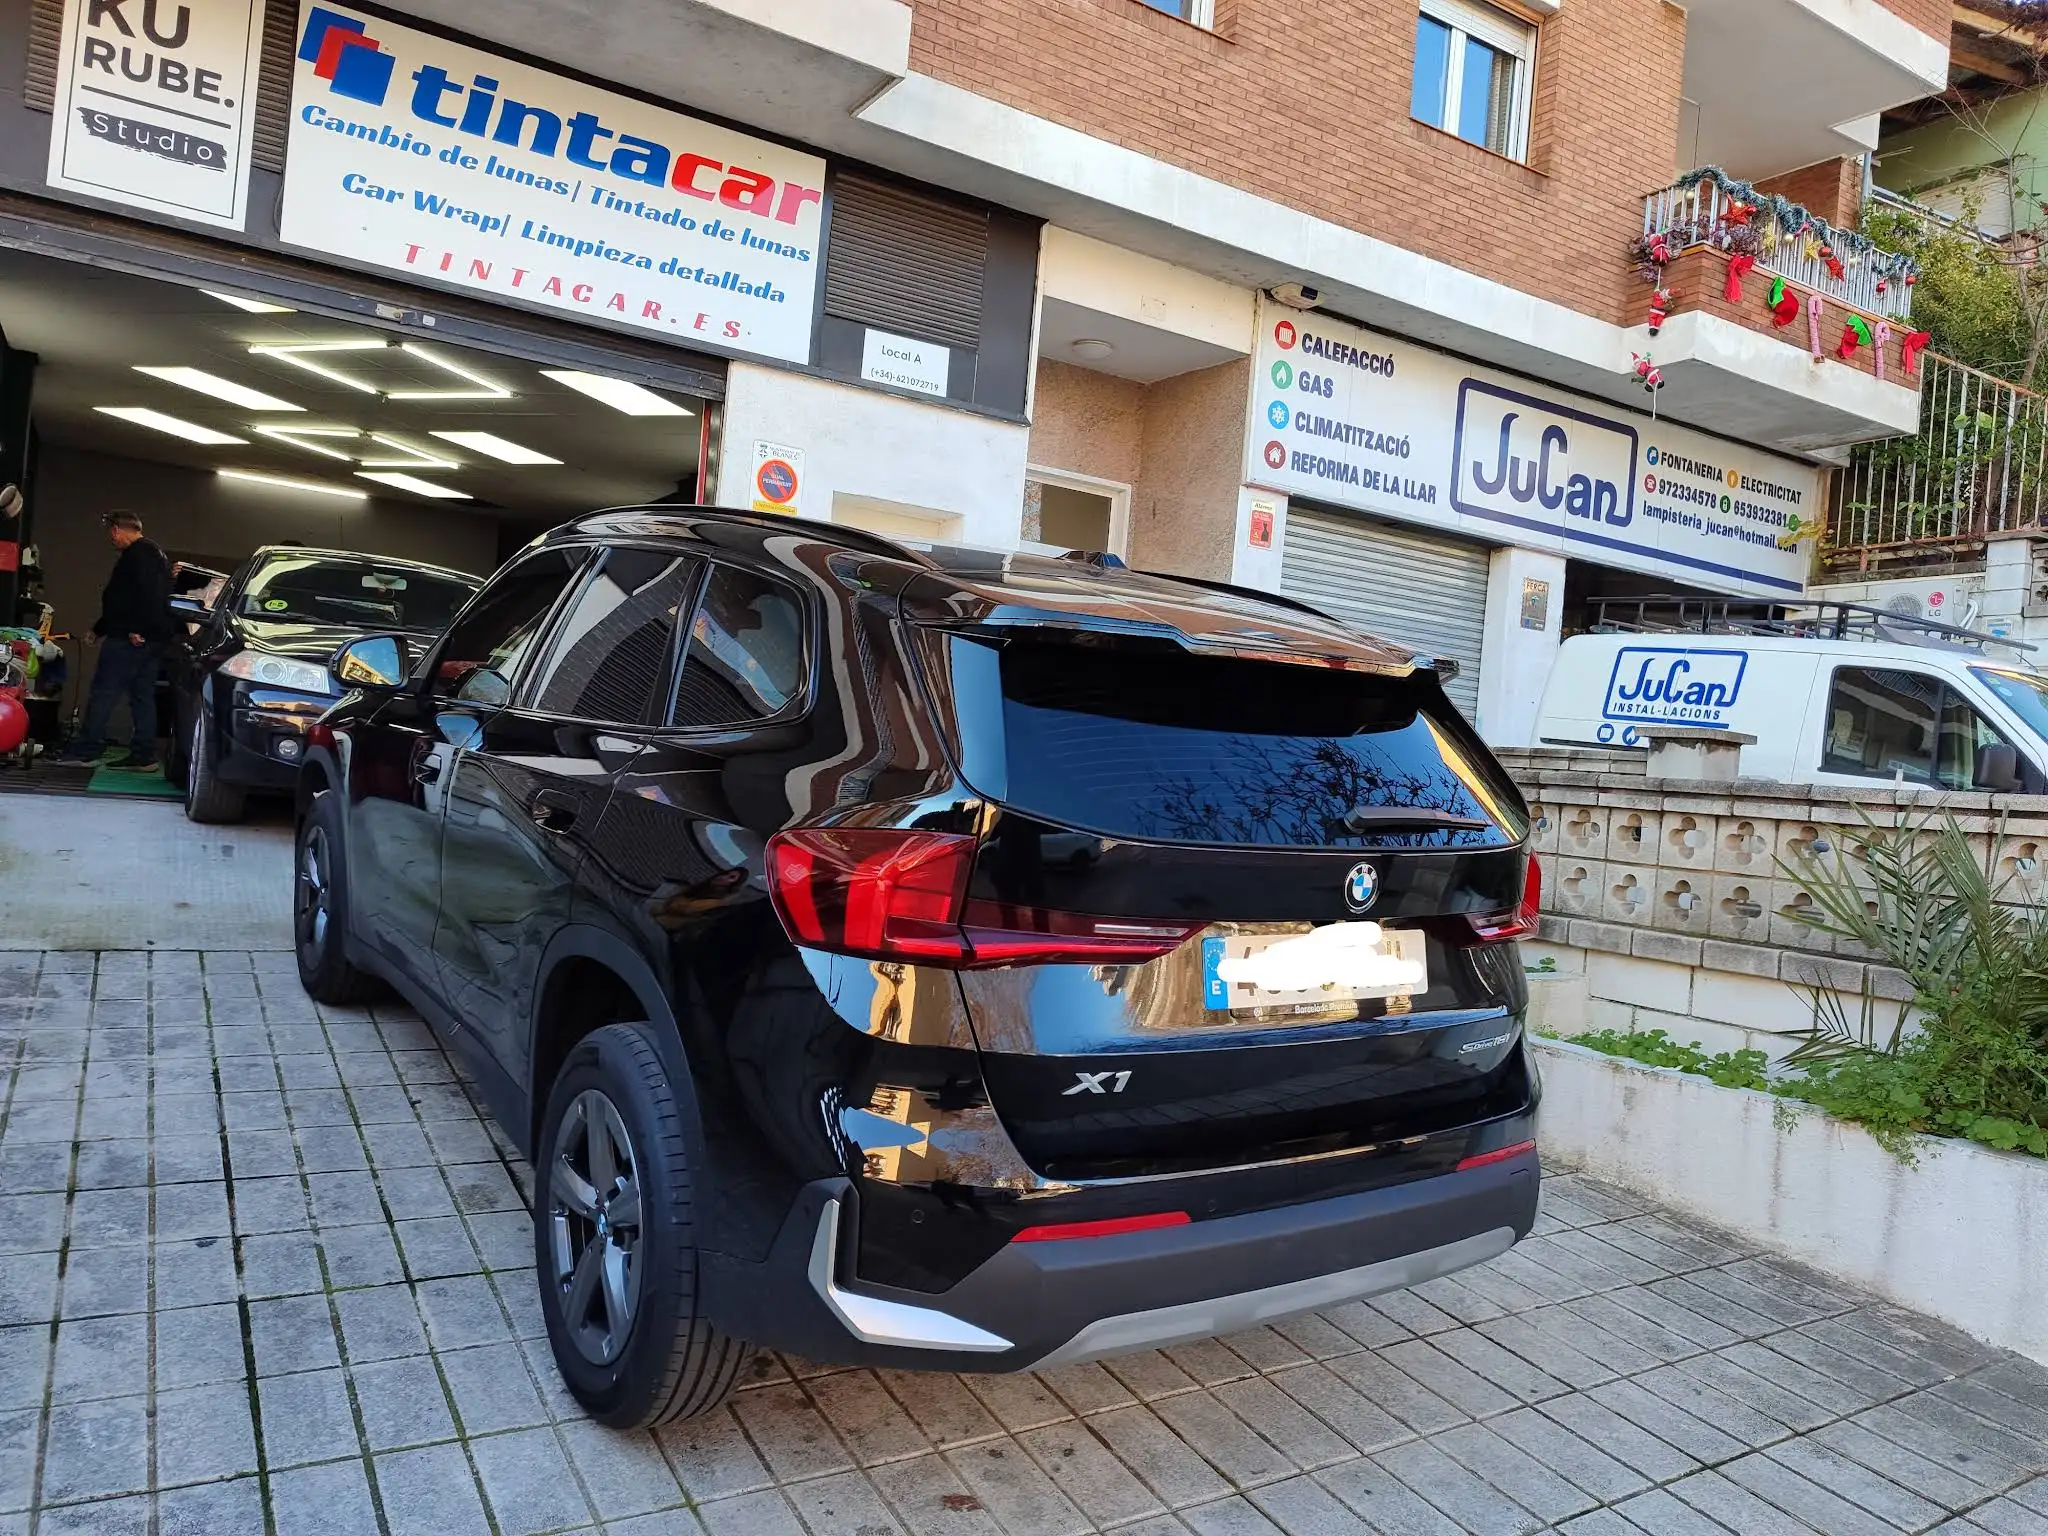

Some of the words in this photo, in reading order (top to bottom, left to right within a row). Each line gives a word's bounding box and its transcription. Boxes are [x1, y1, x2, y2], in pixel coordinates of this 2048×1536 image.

[88, 0, 191, 49] KU
[83, 36, 235, 108] RUBE.
[411, 64, 822, 226] tintacar
[301, 104, 432, 157] Cambio
[438, 145, 479, 170] de
[589, 185, 697, 232] Tintado
[702, 219, 736, 243] de
[740, 228, 811, 263] lunas
[342, 173, 405, 204] Car
[520, 220, 653, 271] Limpieza
[658, 257, 786, 304] detallada
[870, 367, 939, 391] (+34)-621072719
[881, 344, 911, 362] Local
[913, 353, 922, 365] A
[1301, 332, 1395, 378] CALEFACCIÓ
[1298, 370, 1334, 399] GAS
[1294, 411, 1411, 459] CLIMATITZACIÓ
[1290, 450, 1359, 486] REFORMA
[1362, 468, 1381, 491] DE
[1382, 474, 1400, 496] LA
[1403, 478, 1437, 505] LLAR
[1472, 412, 1631, 528] JuCan
[1660, 451, 1723, 483] FONTANERIA
[1740, 475, 1802, 505] ELECTRICITAT
[1658, 478, 1717, 509] 972334578
[1733, 500, 1787, 528] 653932381
[1928, 609, 1942, 617] LG
[1618, 657, 1737, 708] JuCan
[1211, 979, 1222, 996] E
[1061, 1070, 1132, 1096] X1
